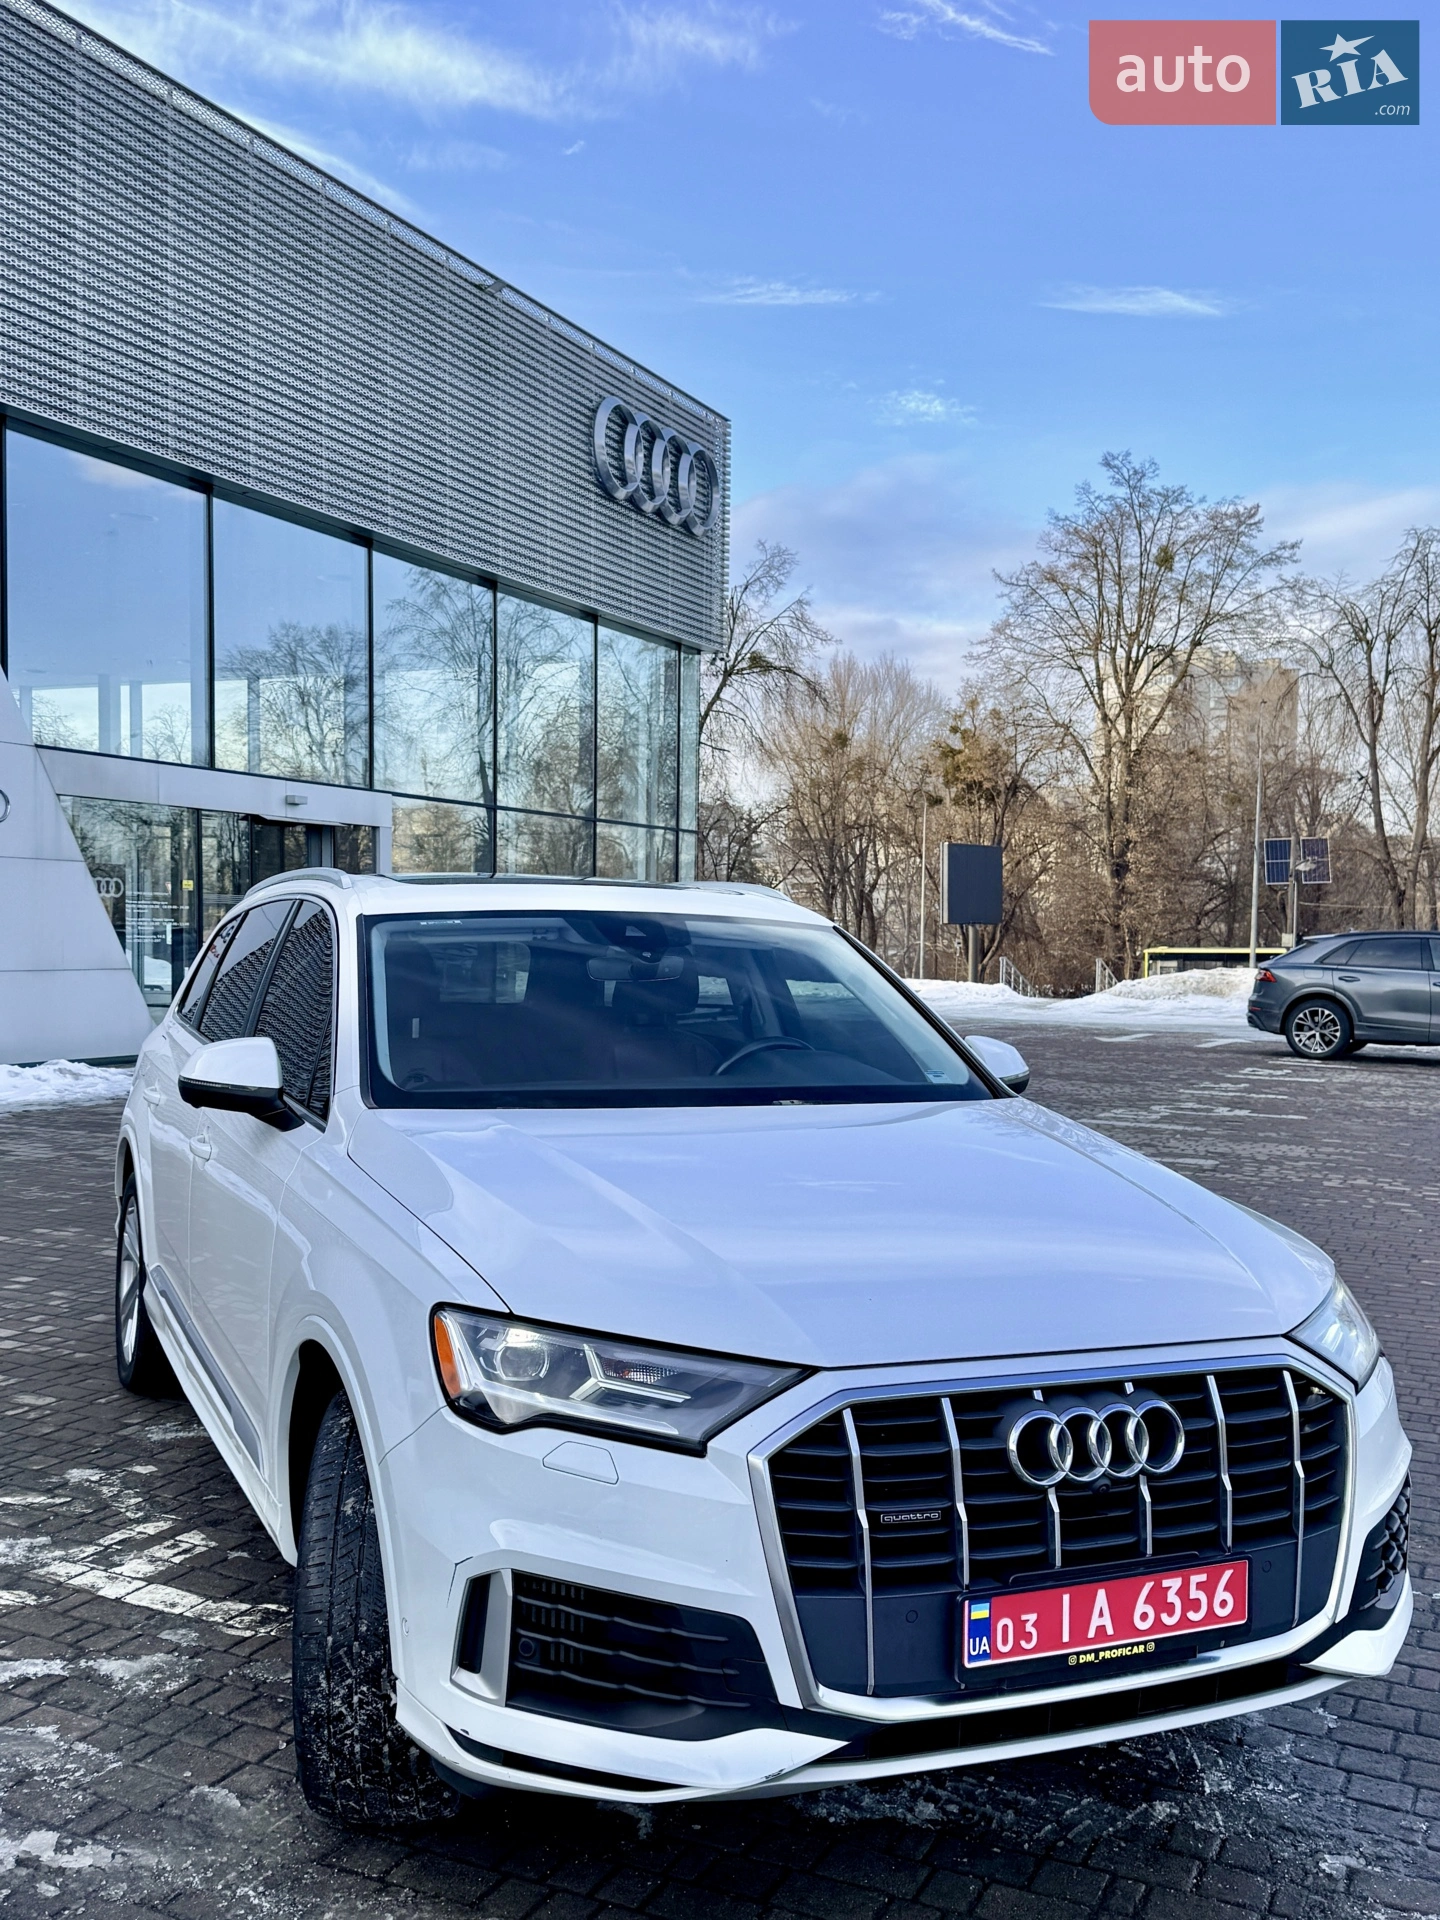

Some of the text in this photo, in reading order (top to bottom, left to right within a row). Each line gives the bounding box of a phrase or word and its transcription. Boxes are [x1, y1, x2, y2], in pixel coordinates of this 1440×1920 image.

[884, 1512, 939, 1523] quattro
[996, 1612, 1039, 1653] 03
[1133, 1568, 1235, 1632] 6356
[969, 1635, 991, 1656] UA
[1078, 1644, 1146, 1664] DM_PROFICAR
